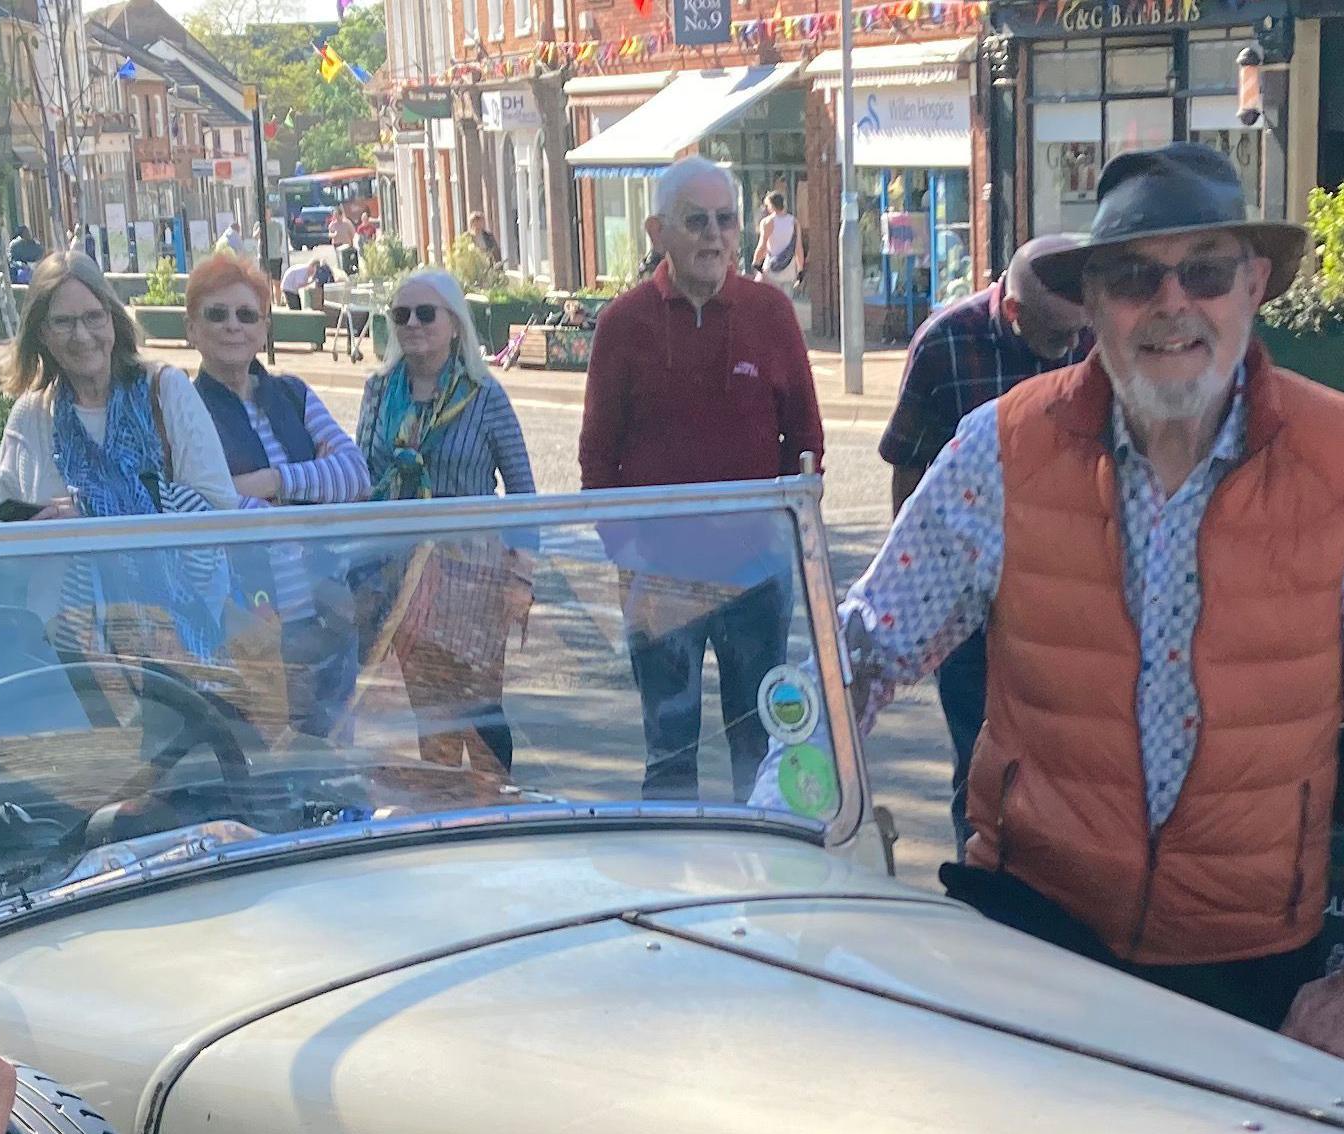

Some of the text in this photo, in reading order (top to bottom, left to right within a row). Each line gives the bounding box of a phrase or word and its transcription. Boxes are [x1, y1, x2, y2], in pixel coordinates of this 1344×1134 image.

[502, 95, 524, 110] DH
[888, 96, 955, 125] Willen Hospice
